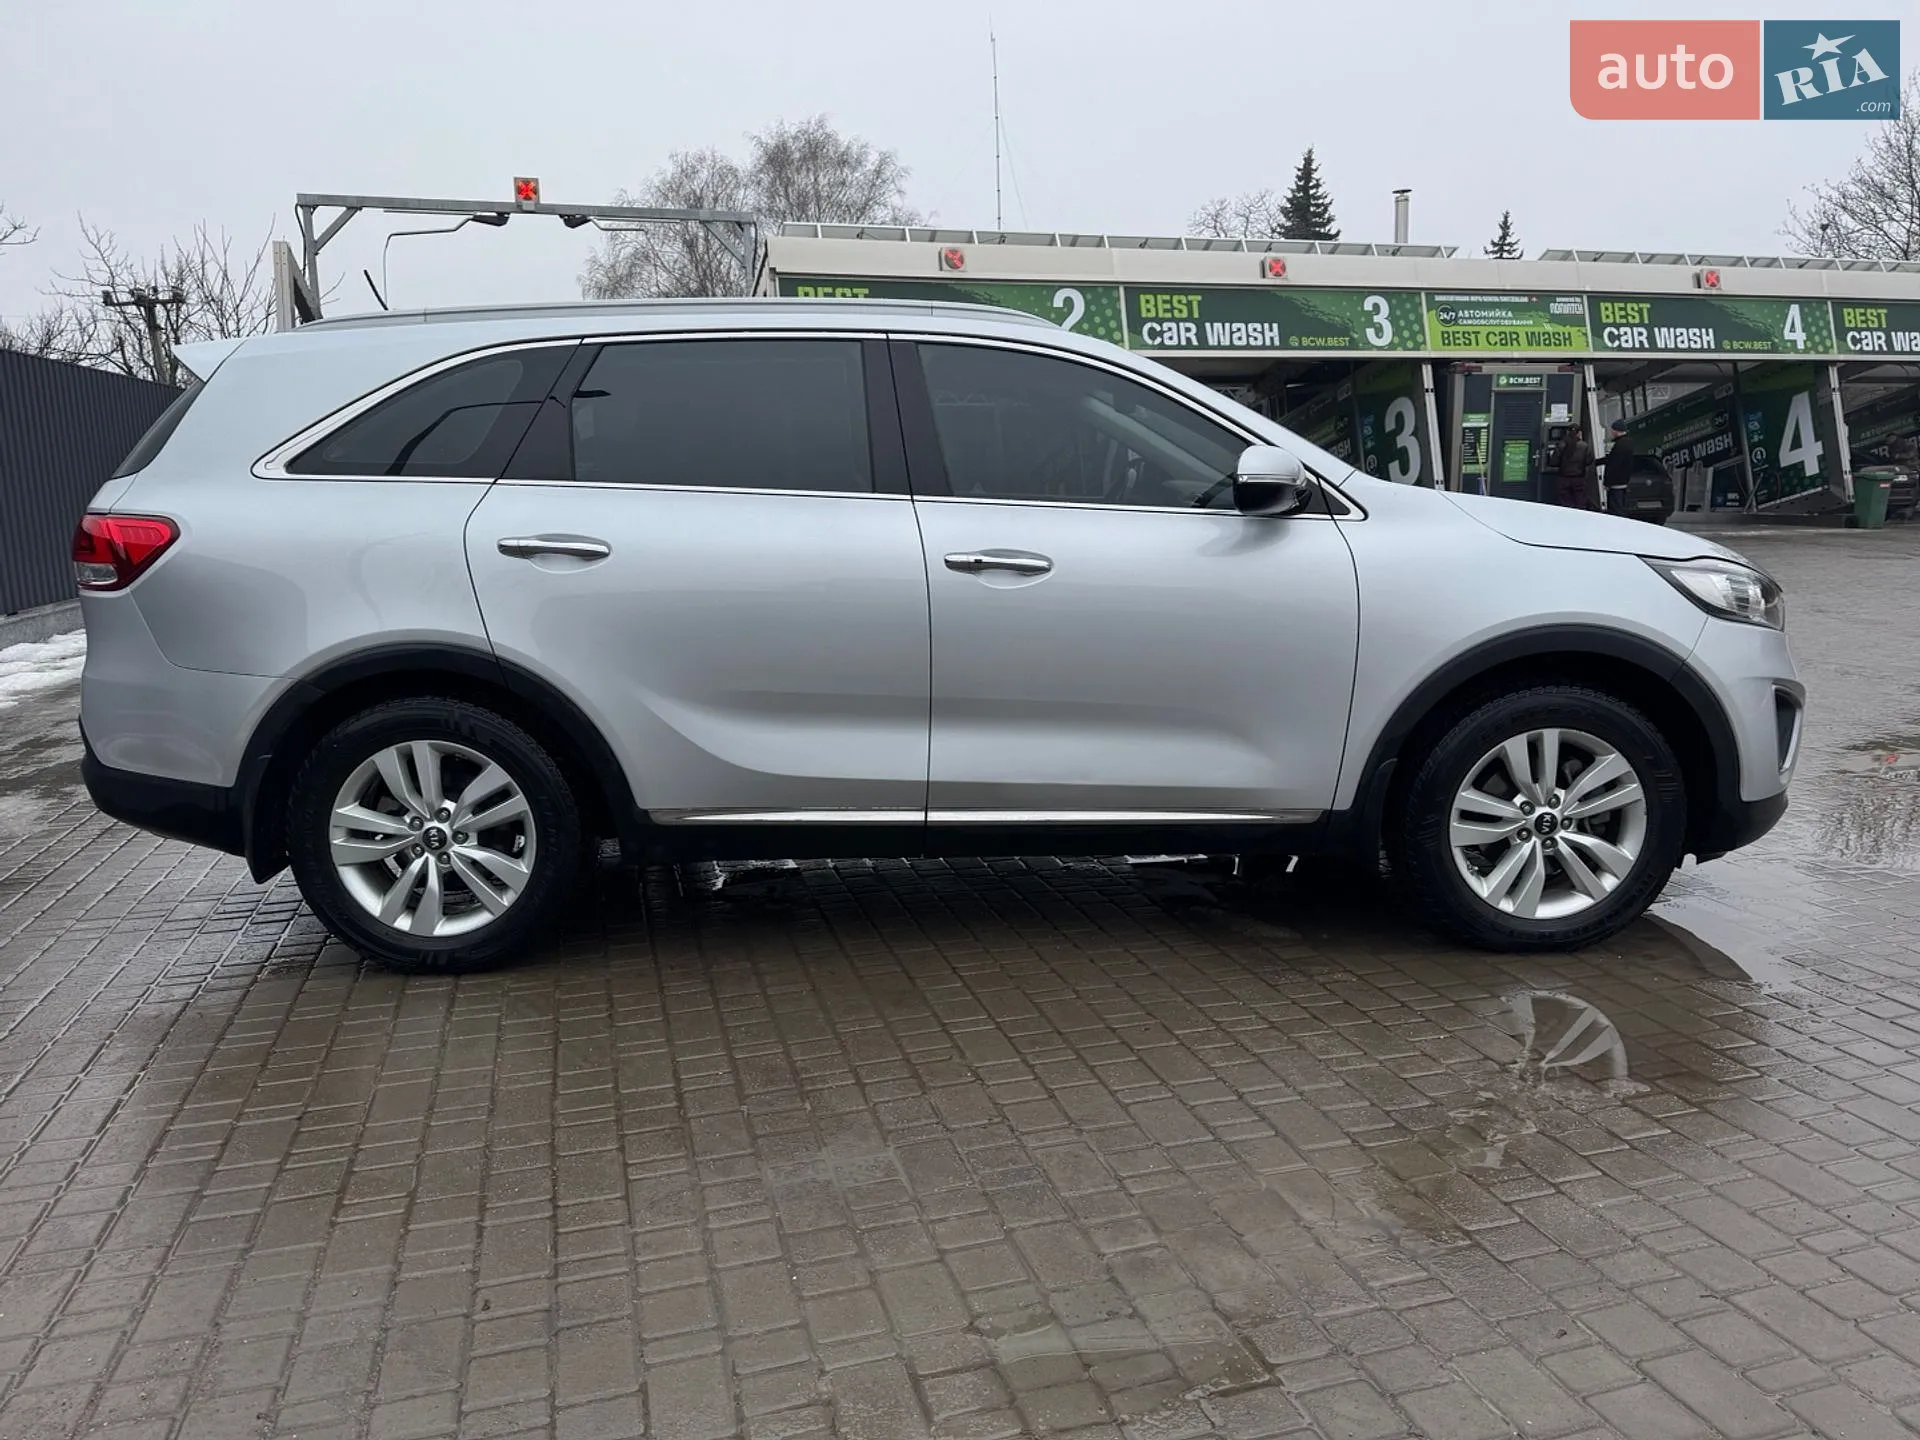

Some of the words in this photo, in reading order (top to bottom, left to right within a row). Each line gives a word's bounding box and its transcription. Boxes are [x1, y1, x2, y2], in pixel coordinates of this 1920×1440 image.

[1053, 288, 1085, 332] 2
[1139, 294, 1202, 318] BEST
[1458, 308, 1513, 318] АВТОМИЙКА
[1600, 302, 1651, 324] BEST
[1363, 295, 1394, 347] 3
[1783, 304, 1806, 349] 4
[1843, 308, 1888, 328] BEST
[1441, 331, 1480, 346] BEST
[1384, 397, 1421, 485] 3
[1779, 390, 1824, 477] 4
[1542, 814, 1551, 833] KIA
[430, 829, 439, 848] KIA
